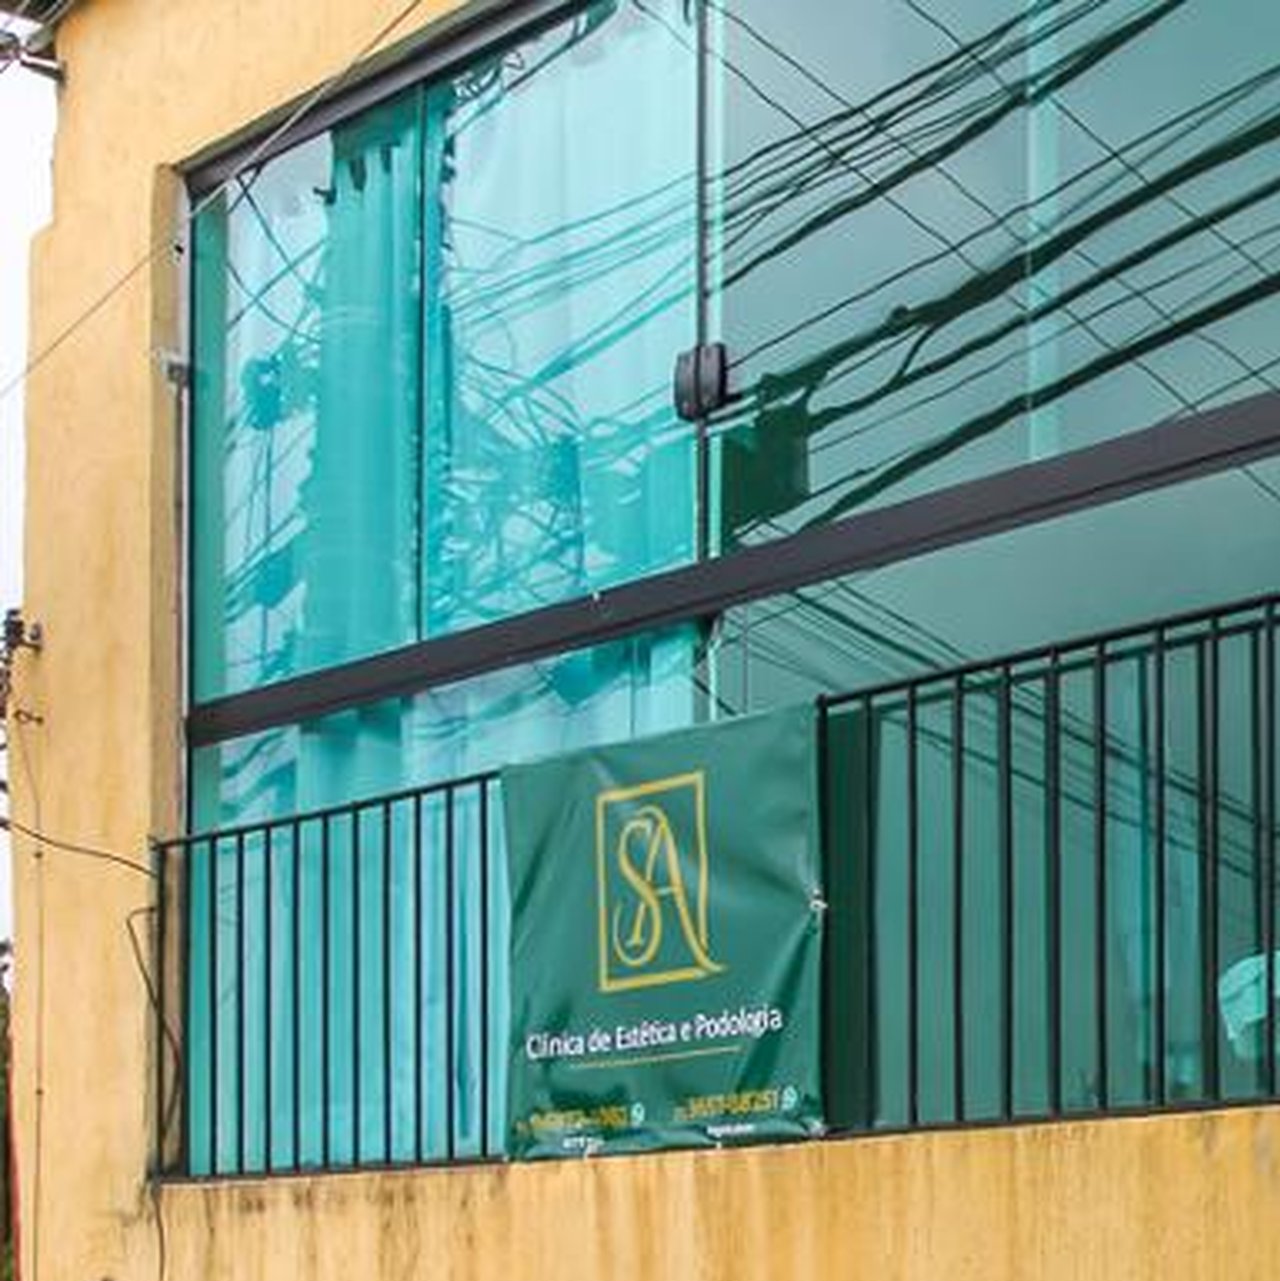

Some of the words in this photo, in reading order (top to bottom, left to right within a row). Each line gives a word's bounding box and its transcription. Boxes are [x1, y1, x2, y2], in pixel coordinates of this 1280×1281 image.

[588, 1027, 612, 1052] de
[615, 1020, 677, 1050] Estética
[680, 1022, 692, 1041] e
[695, 1003, 783, 1040] Podologia
